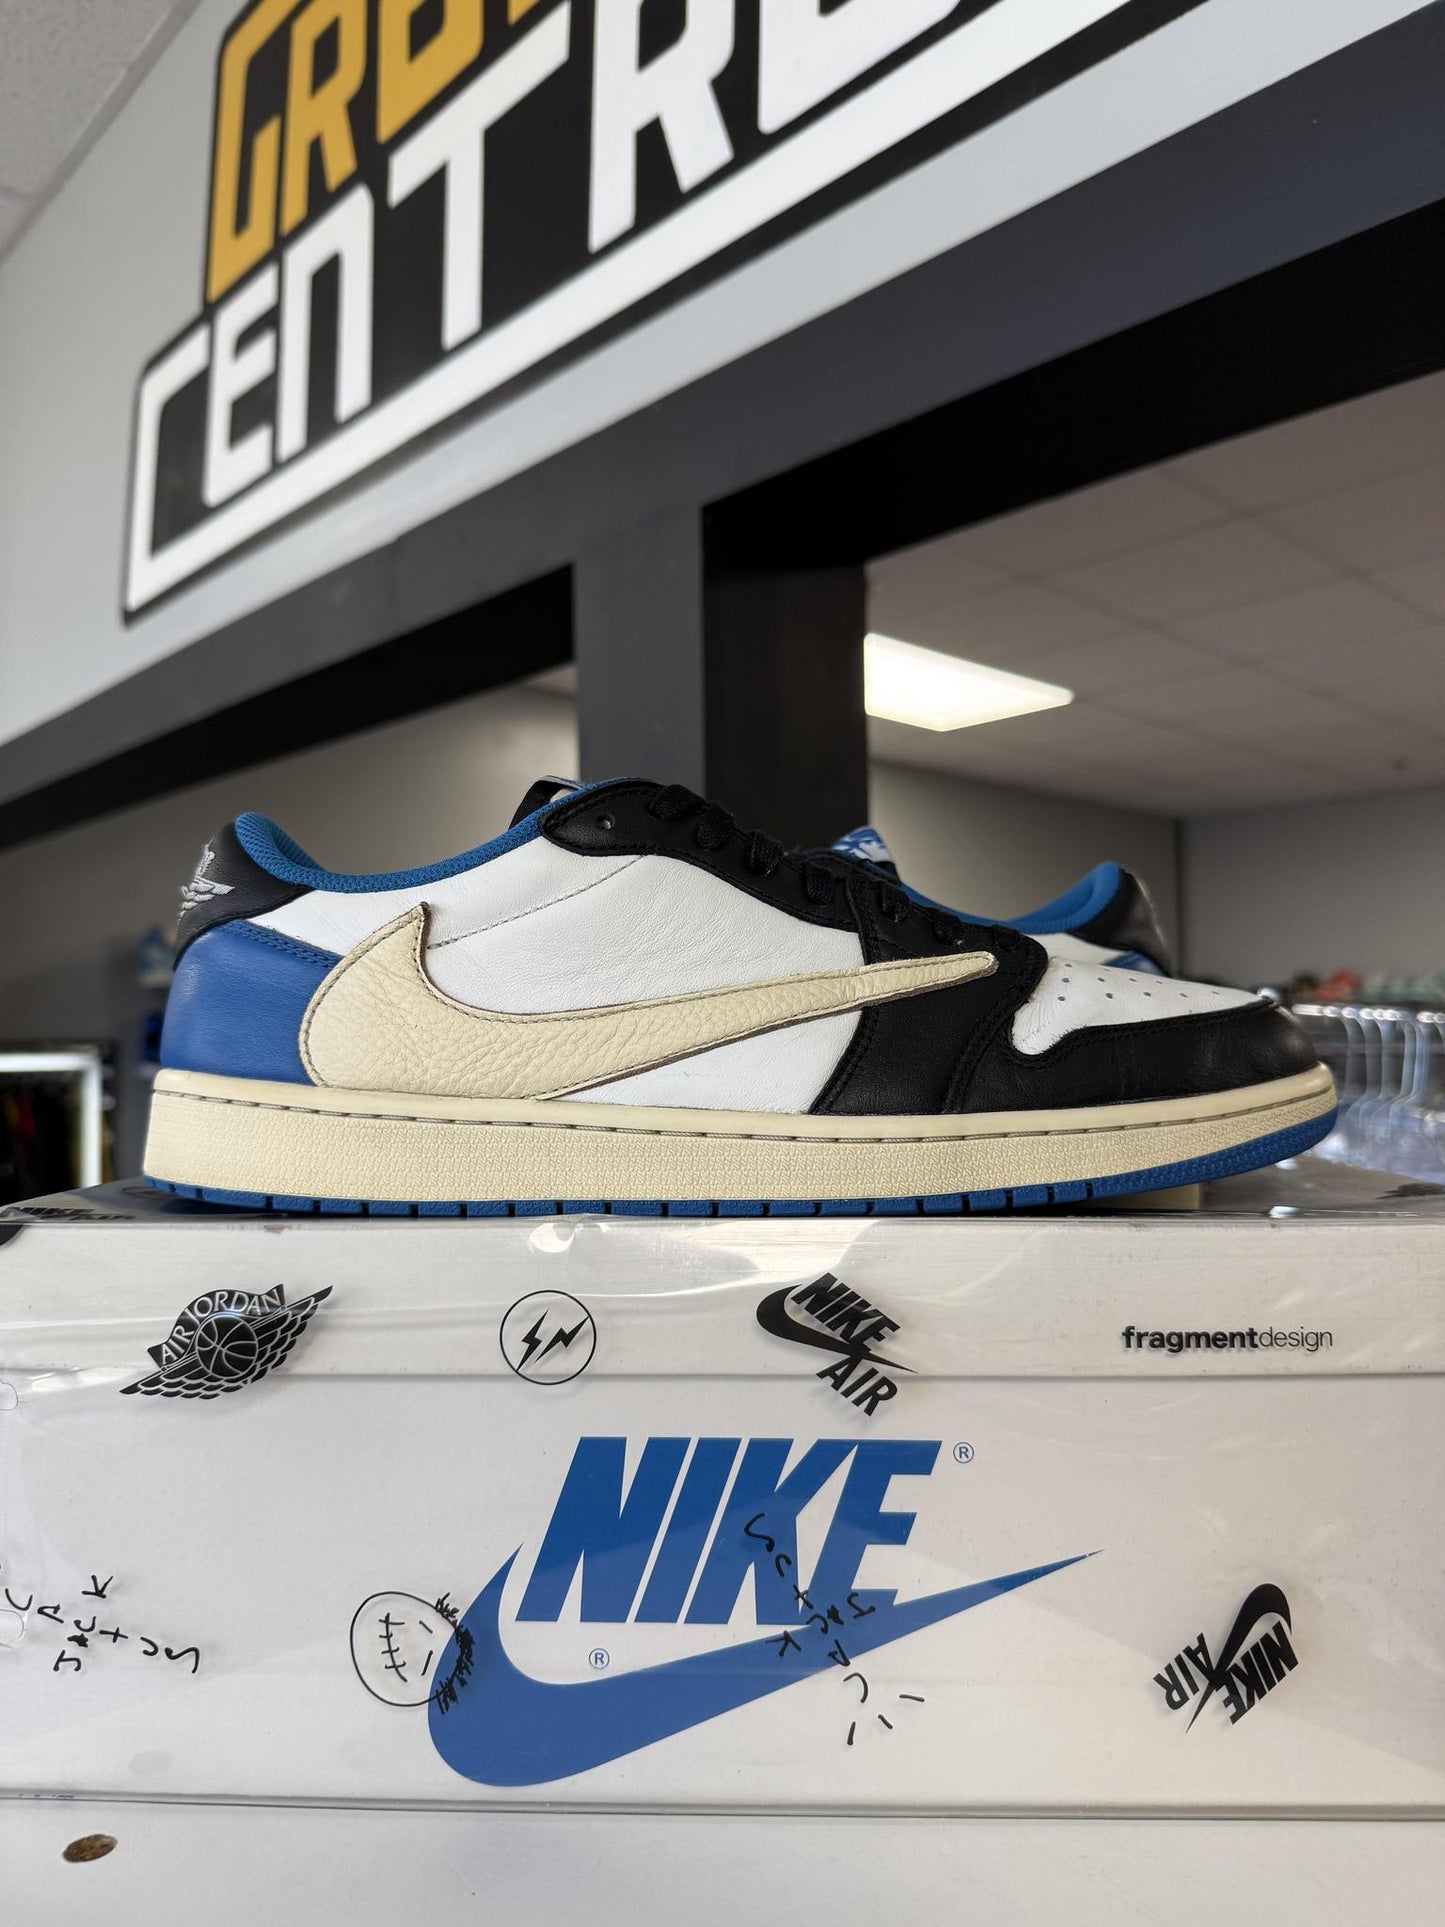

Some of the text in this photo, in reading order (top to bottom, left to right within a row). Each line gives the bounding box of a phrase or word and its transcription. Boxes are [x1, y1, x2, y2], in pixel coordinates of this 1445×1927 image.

[161, 1288, 283, 1365] AIR JORDAN
[791, 1272, 901, 1352] NIKE
[1121, 1326, 1333, 1352] fragmentdesign
[816, 1352, 898, 1417] AIR
[515, 1436, 943, 1625] NIKE
[1153, 1632, 1217, 1711] AIR
[1213, 1620, 1299, 1725] NIKE
